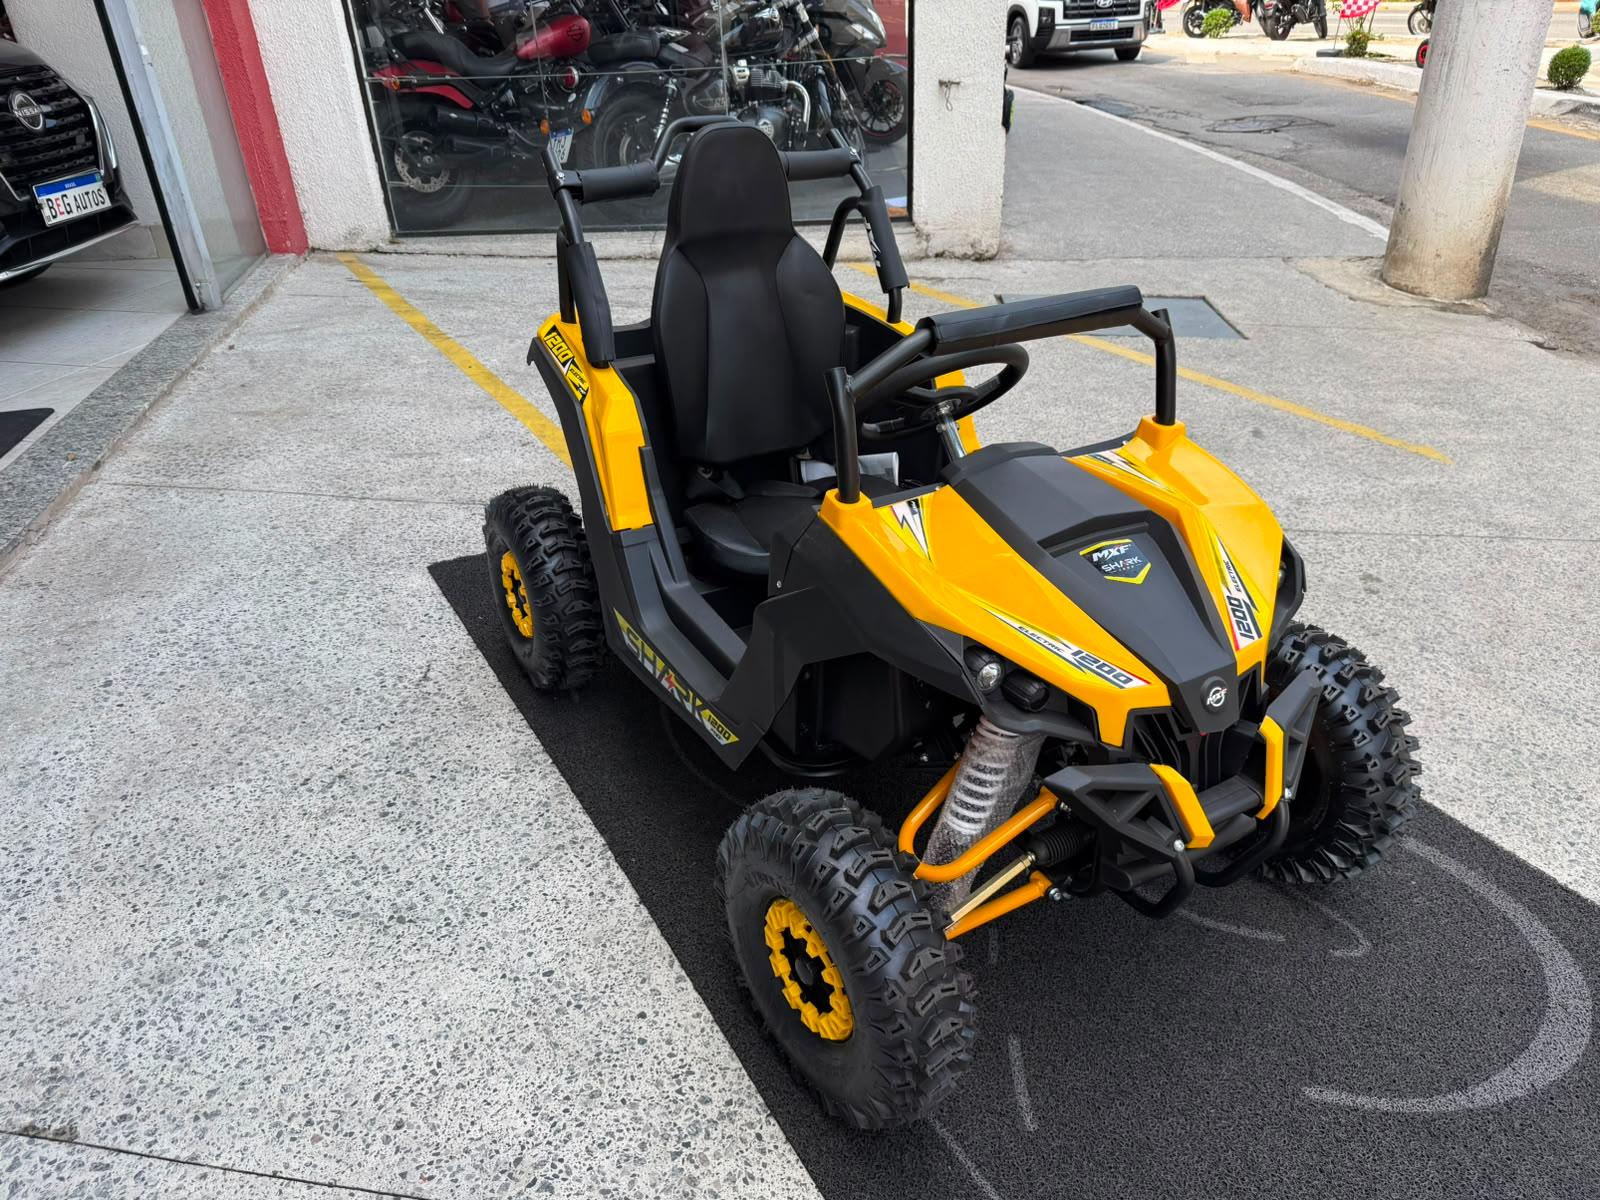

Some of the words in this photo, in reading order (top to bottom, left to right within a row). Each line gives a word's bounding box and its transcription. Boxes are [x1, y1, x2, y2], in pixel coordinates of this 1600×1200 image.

[46, 194, 73, 220] BEG
[73, 188, 106, 213] AUTOS
[1092, 543, 1130, 562] MXF
[1101, 556, 1142, 572] SHARK
[1226, 595, 1255, 640] 1200
[1018, 625, 1065, 653] ELECTRIC
[1071, 648, 1133, 685] 1200
[708, 714, 731, 741] 1200
